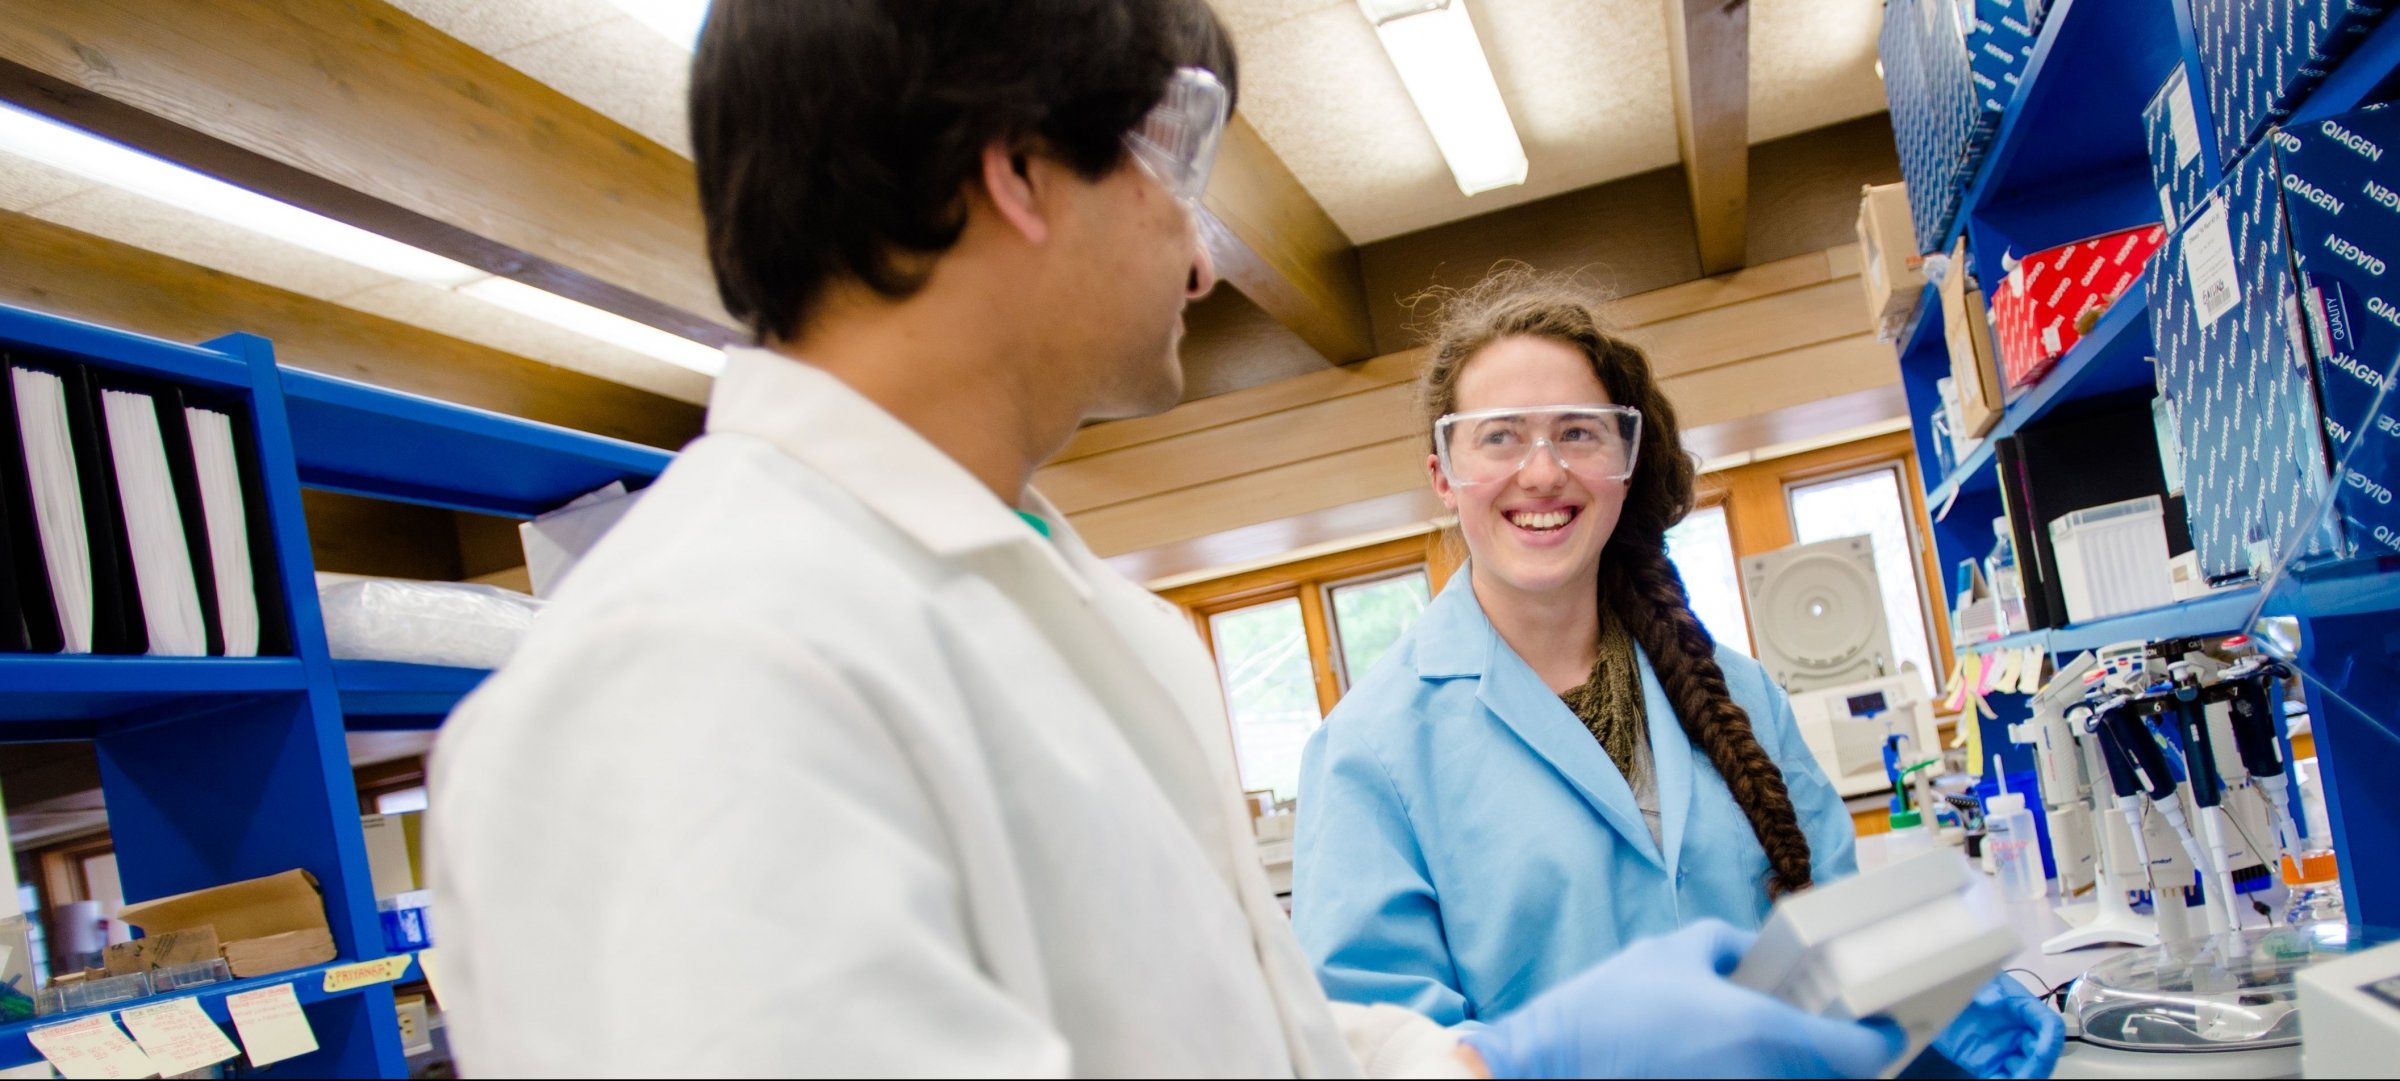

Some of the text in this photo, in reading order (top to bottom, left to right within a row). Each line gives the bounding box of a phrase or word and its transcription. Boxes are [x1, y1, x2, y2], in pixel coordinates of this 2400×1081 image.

[2321, 120, 2384, 162] QIAGEN
[2254, 167, 2264, 224] QIAGEN
[2283, 173, 2345, 216] QIAGEN
[2239, 212, 2249, 265] QIAGEN
[2324, 233, 2386, 276] QIAGEN
[2257, 240, 2267, 294] QIAGEN
[2276, 271, 2286, 327] QIAGEN
[2326, 298, 2345, 340] QUALITY
[2229, 319, 2238, 368] QIAGEN
[2262, 311, 2271, 363] QIAGEN
[2249, 349, 2257, 398] QIAGEN
[2234, 382, 2243, 430] QIAGEN
[2267, 380, 2276, 430] QIAGEN
[2253, 413, 2262, 461] QIAGEN
[2286, 412, 2296, 463] QIAGEN
[2238, 446, 2248, 492] QIAGEN
[2271, 446, 2280, 494] QIAGEN
[2374, 525, 2400, 552] QIA
[2154, 703, 2161, 712] 6
[2233, 687, 2239, 696] 7
